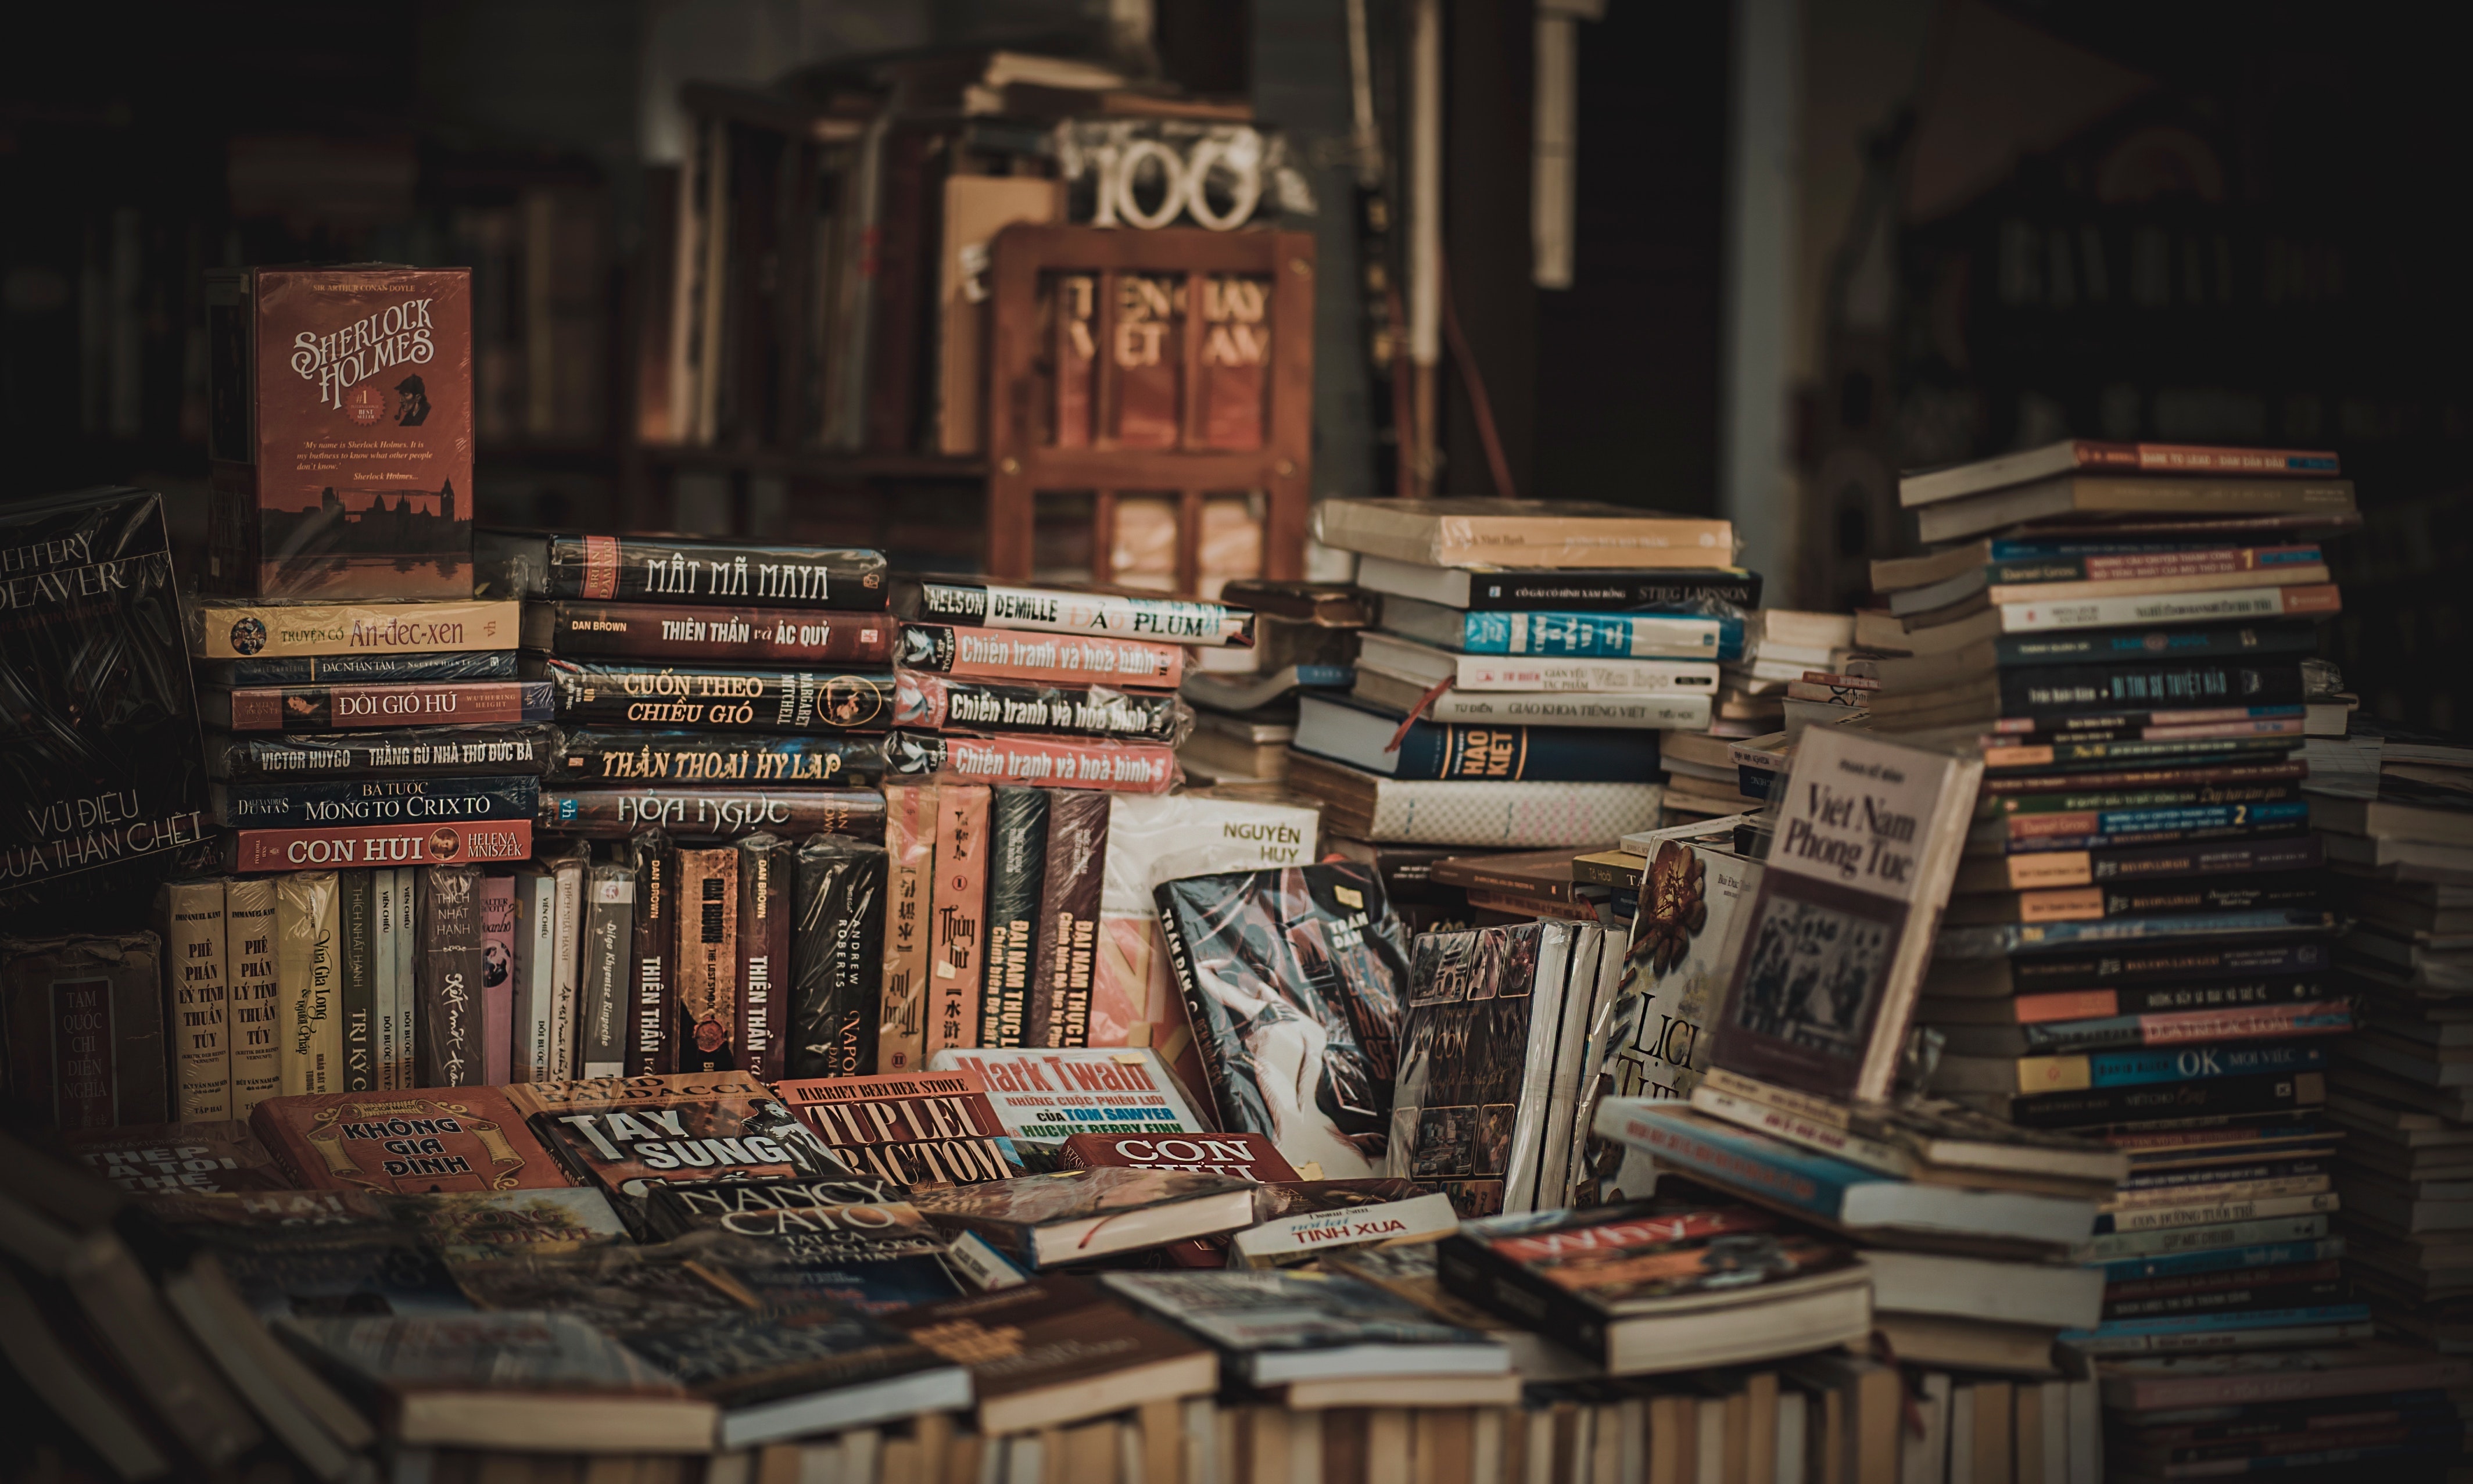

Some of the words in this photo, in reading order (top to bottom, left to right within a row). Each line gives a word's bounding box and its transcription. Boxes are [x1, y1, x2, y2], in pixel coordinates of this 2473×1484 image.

[291, 298, 434, 379] SHERLOCK
[319, 329, 433, 410] HOLMES
[348, 440, 378, 449] Sherlock
[410, 452, 432, 460] people
[0, 530, 96, 572] EFFERY
[2241, 549, 2254, 570] 1
[590, 551, 600, 589] BRIAN
[709, 556, 748, 596] MÃ
[758, 564, 829, 600] MAYA
[929, 588, 985, 616] NELSON
[994, 593, 1058, 622] DEMILLE
[1133, 611, 1205, 637] PLUM
[572, 621, 592, 631] DAN
[593, 621, 627, 632] BROWN
[662, 616, 705, 641] THIÊN
[709, 615, 750, 643] THẦN
[754, 625, 772, 640] và
[775, 620, 796, 645] ÁC
[962, 634, 1009, 667] Chiến
[1013, 640, 1056, 669] tranh
[1060, 644, 1078, 671] và
[623, 668, 691, 696] CUỐN
[698, 676, 763, 698] THEO
[340, 692, 377, 715] ĐỒI
[382, 691, 421, 714] GIÓ
[425, 691, 457, 712] HÚ
[628, 696, 701, 722] CHIỀU
[709, 703, 754, 724] GIÓ
[952, 692, 1001, 723] Chiến
[1003, 697, 1048, 727] tranh
[1052, 701, 1070, 728] và
[1542, 701, 1578, 716] KHOA
[262, 751, 306, 771] VICTOR
[310, 750, 350, 768] HUYGO
[369, 741, 410, 766] THẰNG
[413, 744, 432, 765] GÙ
[433, 743, 459, 764] NHÀ
[517, 739, 533, 761] BÀ
[602, 744, 671, 778] THẦN
[956, 744, 1003, 776] Chiến
[1008, 748, 1052, 777] tranh
[1057, 753, 1074, 779] và
[28, 801, 72, 837] VŨ
[78, 788, 138, 830] ĐIỆU
[238, 798, 289, 815] DUMAS
[248, 798, 282, 806] ALEXANDRE
[464, 795, 490, 814] TÔ
[562, 800, 575, 818] vh
[2234, 804, 2247, 825] 2
[838, 802, 848, 830] DAN
[1855, 795, 1916, 843] Nam
[53, 830, 120, 868] THẦN
[288, 838, 357, 863] CON
[363, 833, 424, 862] HỦI
[468, 832, 517, 846] HELENA
[468, 844, 522, 858] MNISZEK
[1784, 818, 1861, 879] Phong
[1260, 844, 1299, 862] HUY
[651, 860, 660, 880] DAN
[758, 860, 766, 880] DAN
[352, 887, 364, 919] THÍCH
[650, 883, 659, 919] BROWN
[702, 879, 723, 901] DAN
[757, 882, 766, 919] BROWN
[232, 909, 263, 919] IMMANUEL
[701, 904, 722, 944] BROWN
[245, 935, 268, 955] PHÊ
[605, 923, 615, 949] Dilgo
[1008, 920, 1028, 948] ĐẠI
[1073, 921, 1093, 948] ĐẠI
[189, 939, 213, 958] PHÊ
[707, 949, 715, 962] THE
[836, 920, 846, 988] ROBERTS
[849, 920, 860, 985] ANDREW
[185, 960, 217, 981] PHÁN
[241, 958, 271, 977] PHÁN
[313, 967, 330, 986] Gia
[601, 953, 614, 997] Khyentse
[641, 956, 663, 1004] THIÊN
[748, 956, 771, 1003] THIÊN
[1005, 951, 1026, 988] NAM
[1068, 951, 1090, 988] NAM
[67, 991, 97, 1009] TAM
[198, 984, 224, 1003] TÍNH
[234, 984, 250, 1001] LÝ
[253, 981, 277, 999] TÍNH
[706, 983, 715, 1010] SYMBOL
[63, 1009, 103, 1034] QUỐC
[184, 1003, 222, 1027] THUẦN
[238, 999, 275, 1023] THUẦN
[599, 1001, 612, 1046] Rinpoche
[71, 1031, 96, 1053] CHÍ
[193, 1031, 217, 1049] TÚY
[247, 1027, 271, 1045] TÚY
[640, 1009, 665, 1052] THẦN
[747, 1008, 773, 1051] THẦN
[67, 1054, 102, 1077] DIỄN
[955, 1057, 1055, 1092] Mark
[1043, 1056, 1160, 1092] Twain
[2176, 1048, 2223, 1077] OK
[64, 1078, 107, 1099] NGHĨA
[796, 1084, 856, 1101] HARRIET
[859, 1081, 919, 1097] BEECHER
[919, 1078, 969, 1094] STOWE
[804, 1100, 897, 1146] TÚP
[1037, 1110, 1066, 1122] CỦA
[1063, 1109, 1106, 1121] TOM
[1106, 1107, 1176, 1120] SAWYER
[340, 1117, 464, 1140] KHÔNG
[558, 1110, 690, 1160] TAY
[382, 1138, 447, 1156] GIA
[1114, 1139, 1256, 1162] CON
[382, 1156, 472, 1177] ĐÌNH
[677, 1180, 888, 1214] NANCY
[721, 1205, 896, 1236] CATO
